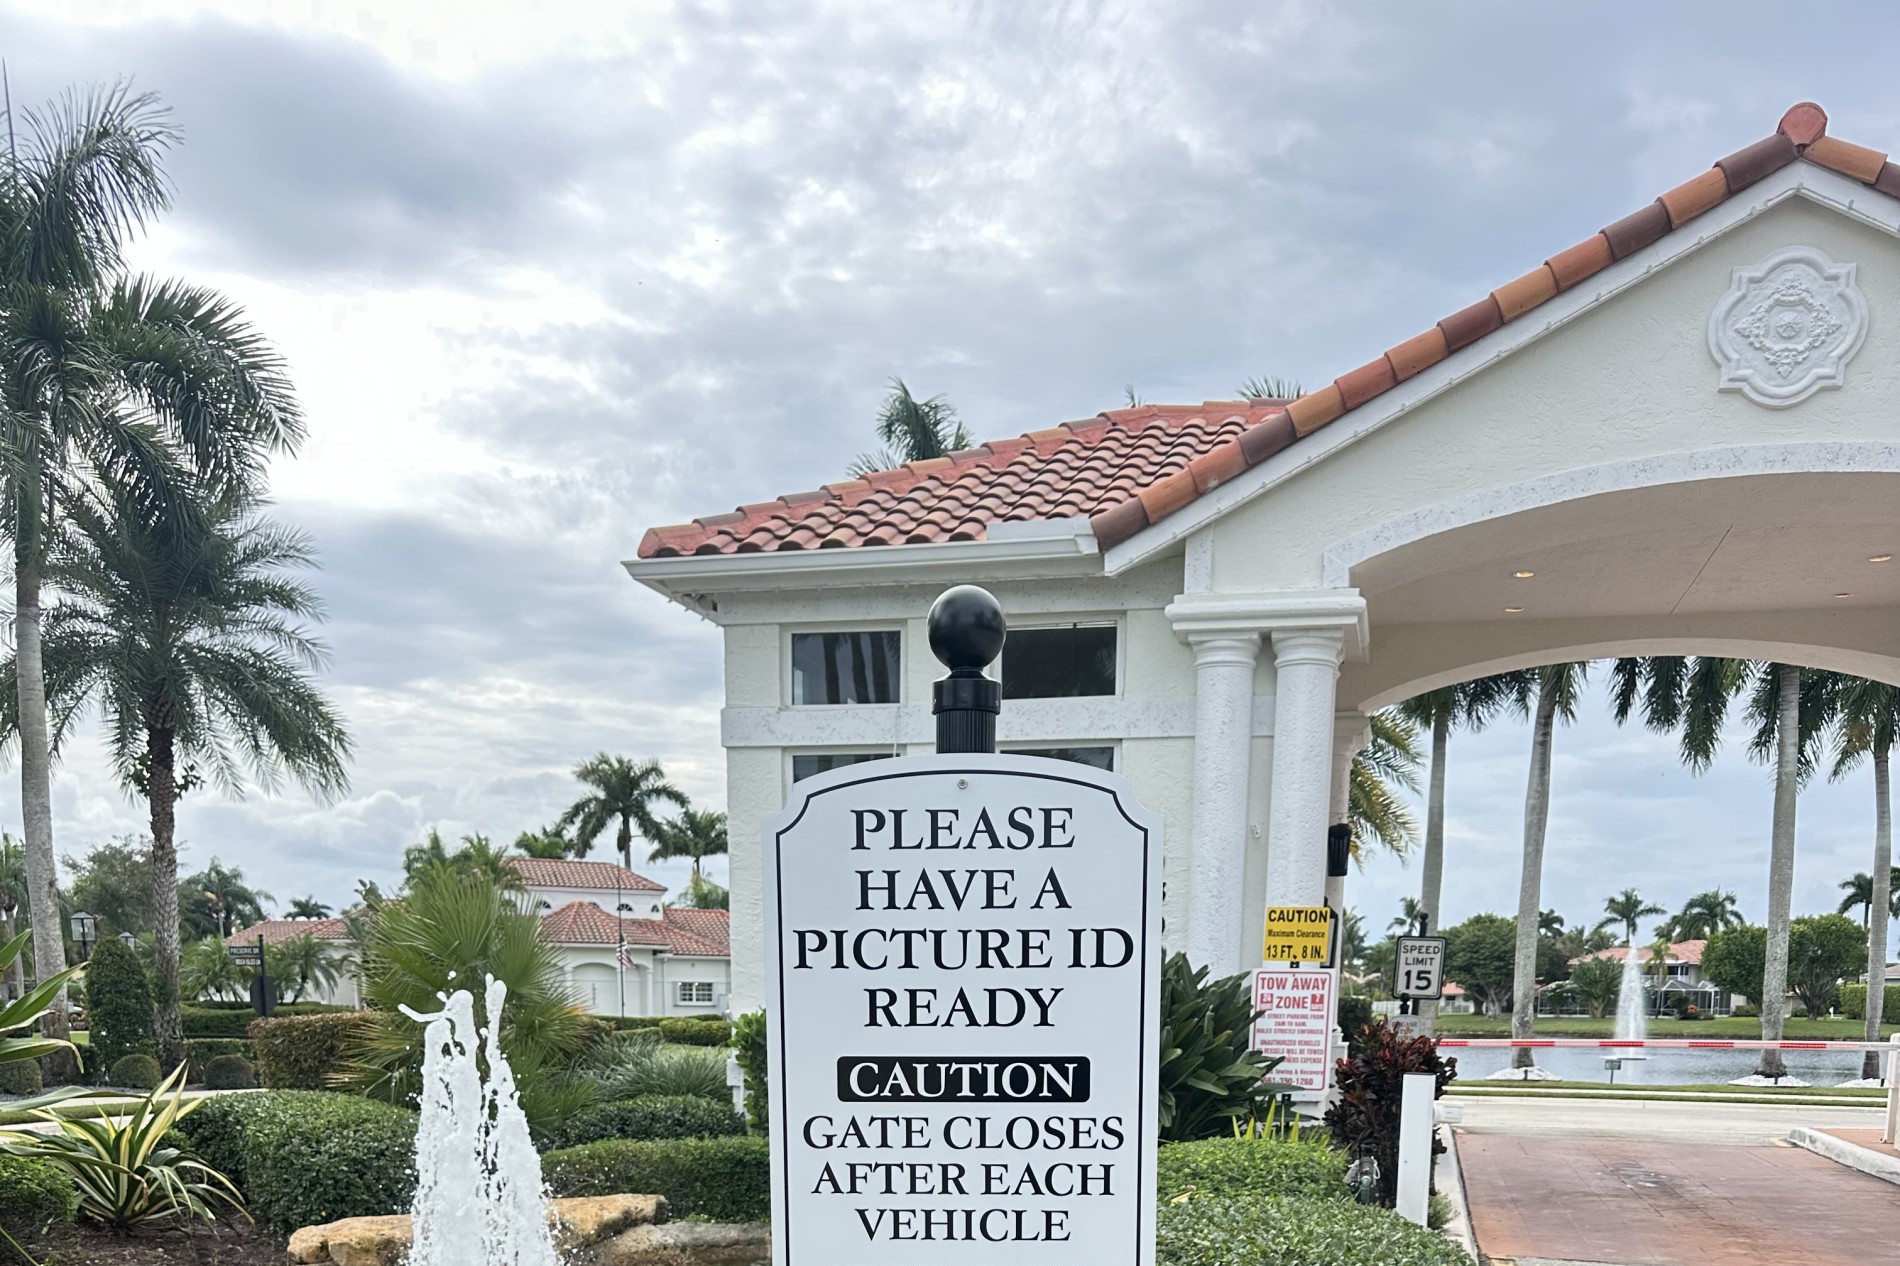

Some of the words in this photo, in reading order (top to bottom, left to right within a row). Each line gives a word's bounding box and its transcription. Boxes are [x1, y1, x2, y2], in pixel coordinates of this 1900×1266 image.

[851, 807, 1075, 850] PLEASE
[855, 867, 1018, 911] HAVE
[1031, 867, 1072, 909] A
[1268, 910, 1328, 923] CAUTION
[1267, 929, 1295, 937] Maximum
[1296, 930, 1325, 938] Clearance
[793, 928, 1052, 970] PICTURE
[1068, 928, 1133, 969] ID
[1267, 945, 1278, 958] 13
[1302, 945, 1308, 958] 8
[1310, 946, 1324, 959] IN.
[1402, 945, 1440, 954] SPEED
[1405, 957, 1435, 966] LIMIT
[1260, 977, 1288, 990] TOW
[1291, 978, 1327, 990] AWAY
[1405, 970, 1432, 990] 15
[864, 987, 1064, 1027] READY
[1275, 996, 1308, 1009] ZONE
[849, 1062, 1076, 1097] CAUTION
[803, 1116, 931, 1149] GATE
[944, 1116, 1124, 1150] CLOSES
[811, 1162, 969, 1195] AFTER
[981, 1163, 1115, 1196] EACH
[855, 1209, 1071, 1241] VEHICLE
